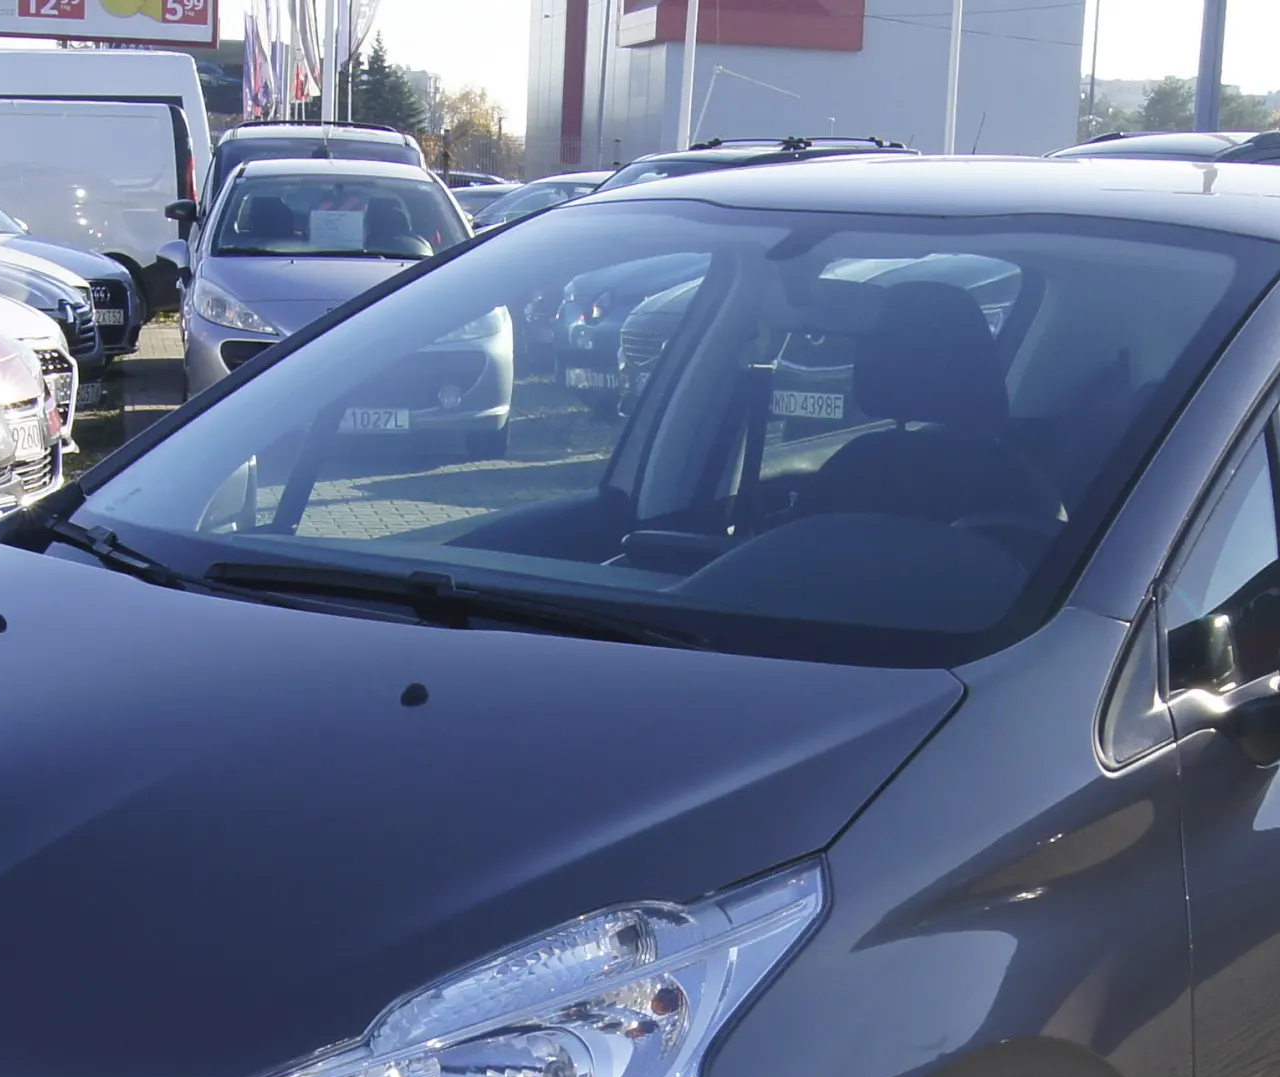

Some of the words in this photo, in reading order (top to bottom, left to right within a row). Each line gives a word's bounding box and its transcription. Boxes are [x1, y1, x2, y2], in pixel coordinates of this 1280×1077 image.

[800, 395, 843, 417] 4398F
[350, 410, 405, 429] 1027L
[12, 424, 41, 450] 9260
